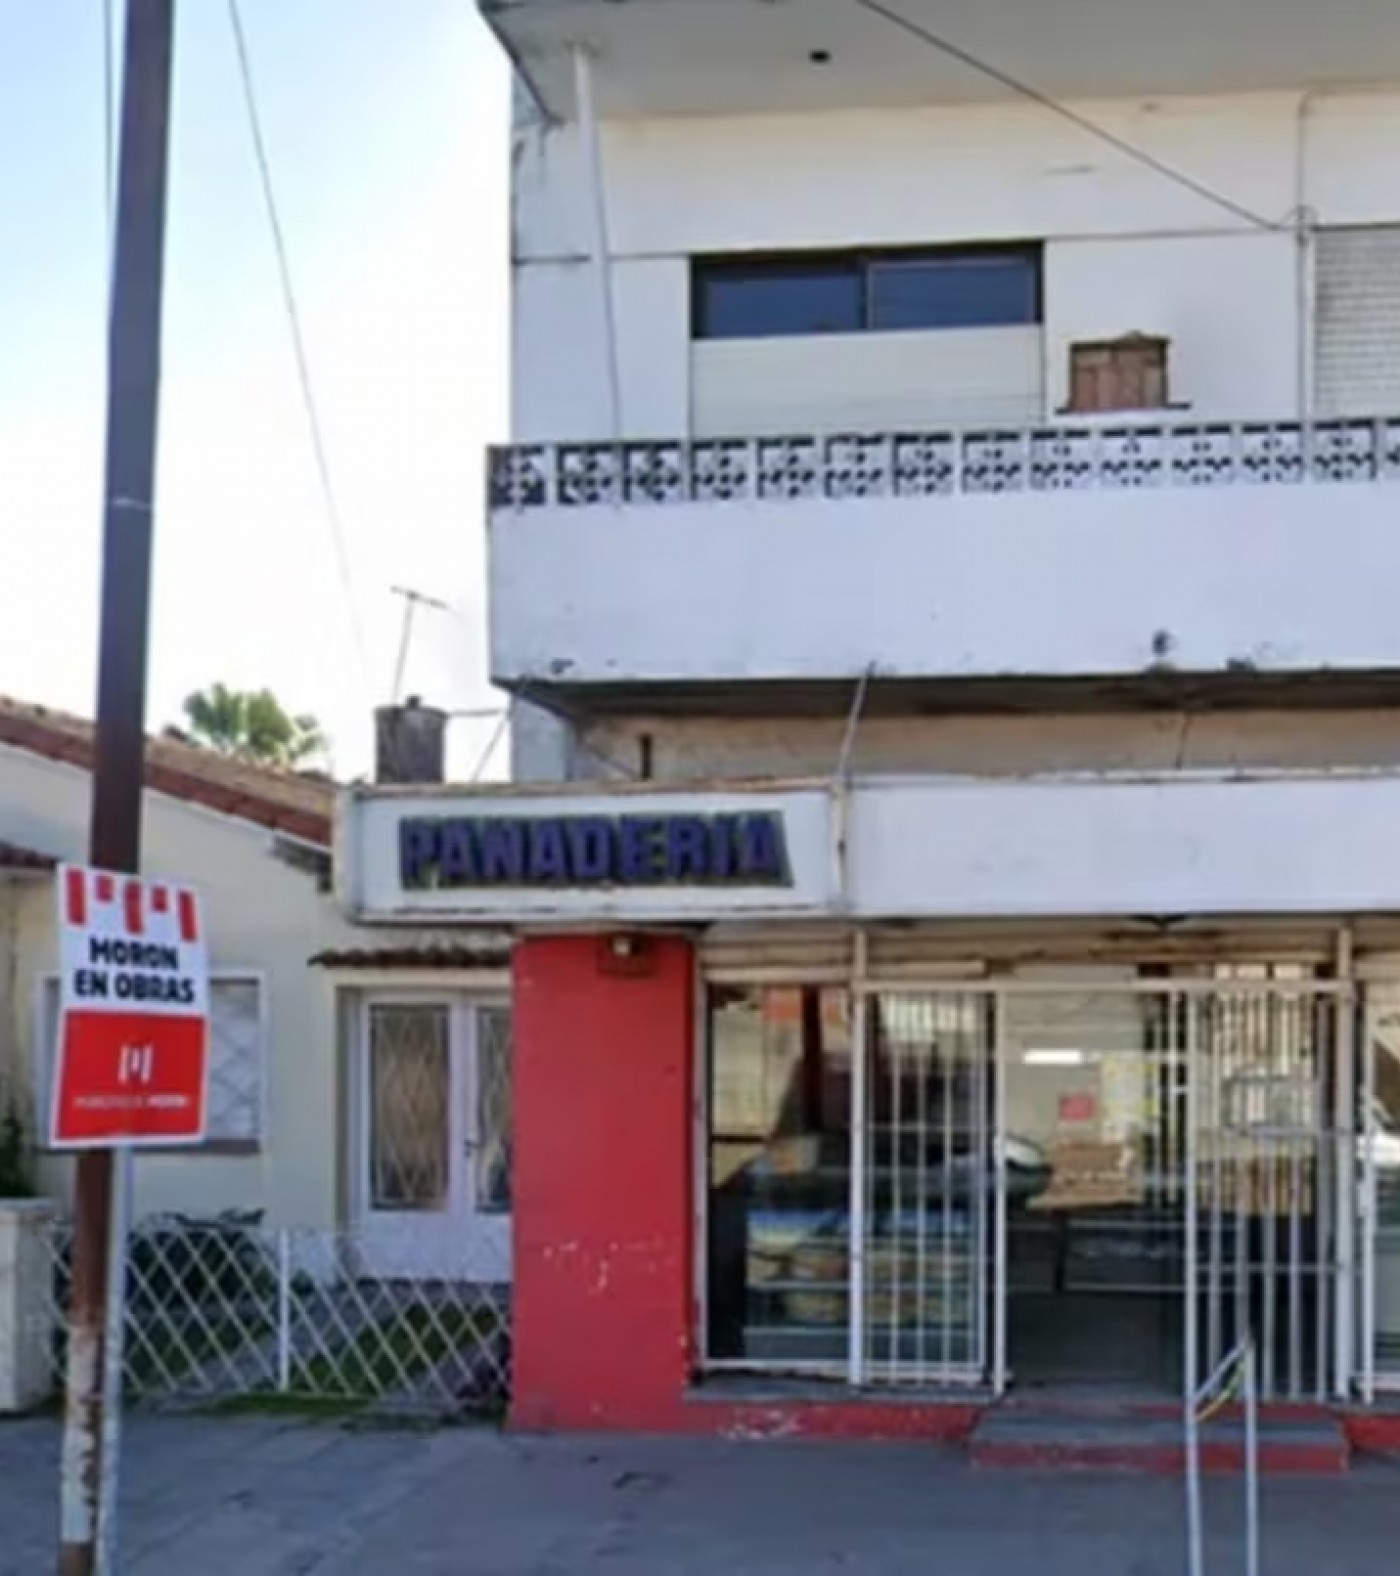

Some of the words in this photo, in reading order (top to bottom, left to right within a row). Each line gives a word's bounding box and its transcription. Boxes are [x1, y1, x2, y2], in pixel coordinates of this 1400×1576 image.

[399, 812, 791, 889] PANADERIA
[88, 936, 178, 969] MORON
[75, 969, 108, 997] EN
[115, 973, 194, 1003] OBRAS
